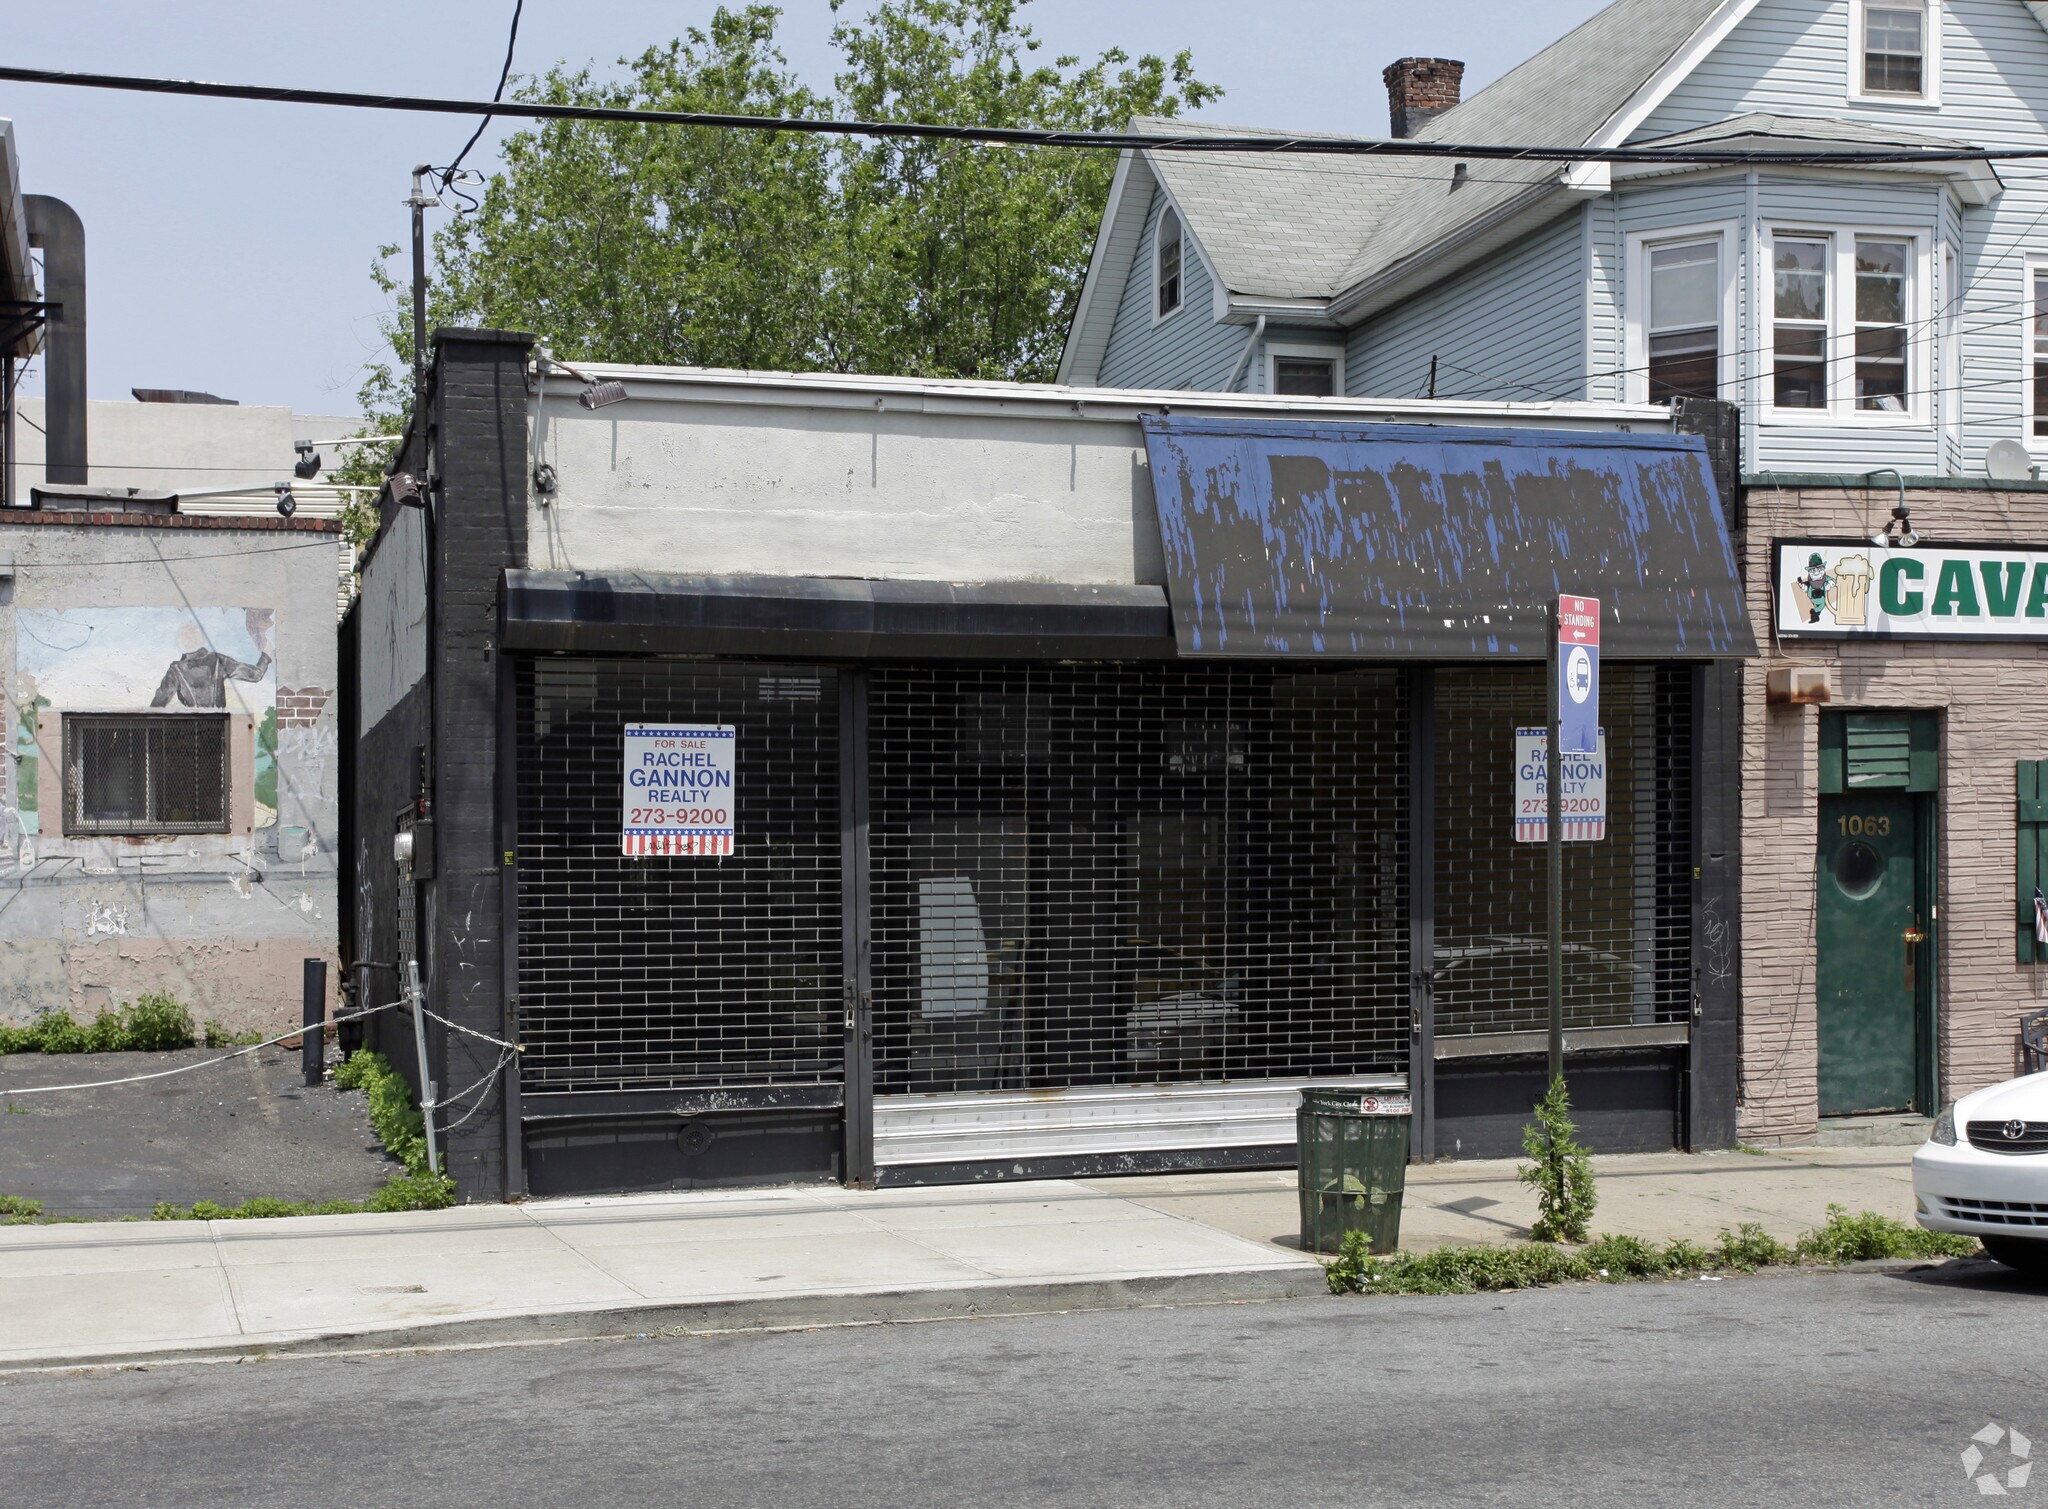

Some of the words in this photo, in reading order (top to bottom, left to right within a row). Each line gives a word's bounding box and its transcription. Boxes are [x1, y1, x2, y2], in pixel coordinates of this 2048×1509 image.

[1574, 599, 1585, 612] NO
[1563, 613, 1595, 628] STANDING
[654, 740, 676, 749] FOR
[680, 740, 706, 749] SALE
[643, 752, 717, 767] RACHEL
[1531, 749, 1591, 762] RAHEL
[629, 768, 730, 787] GANNON
[1520, 763, 1602, 780] GANON
[1536, 782, 1587, 794] RLTY
[648, 789, 710, 803] REALTY
[1522, 798, 1600, 813] 2739200
[630, 808, 727, 824] 273-9200
[1837, 815, 1890, 837] 1063
